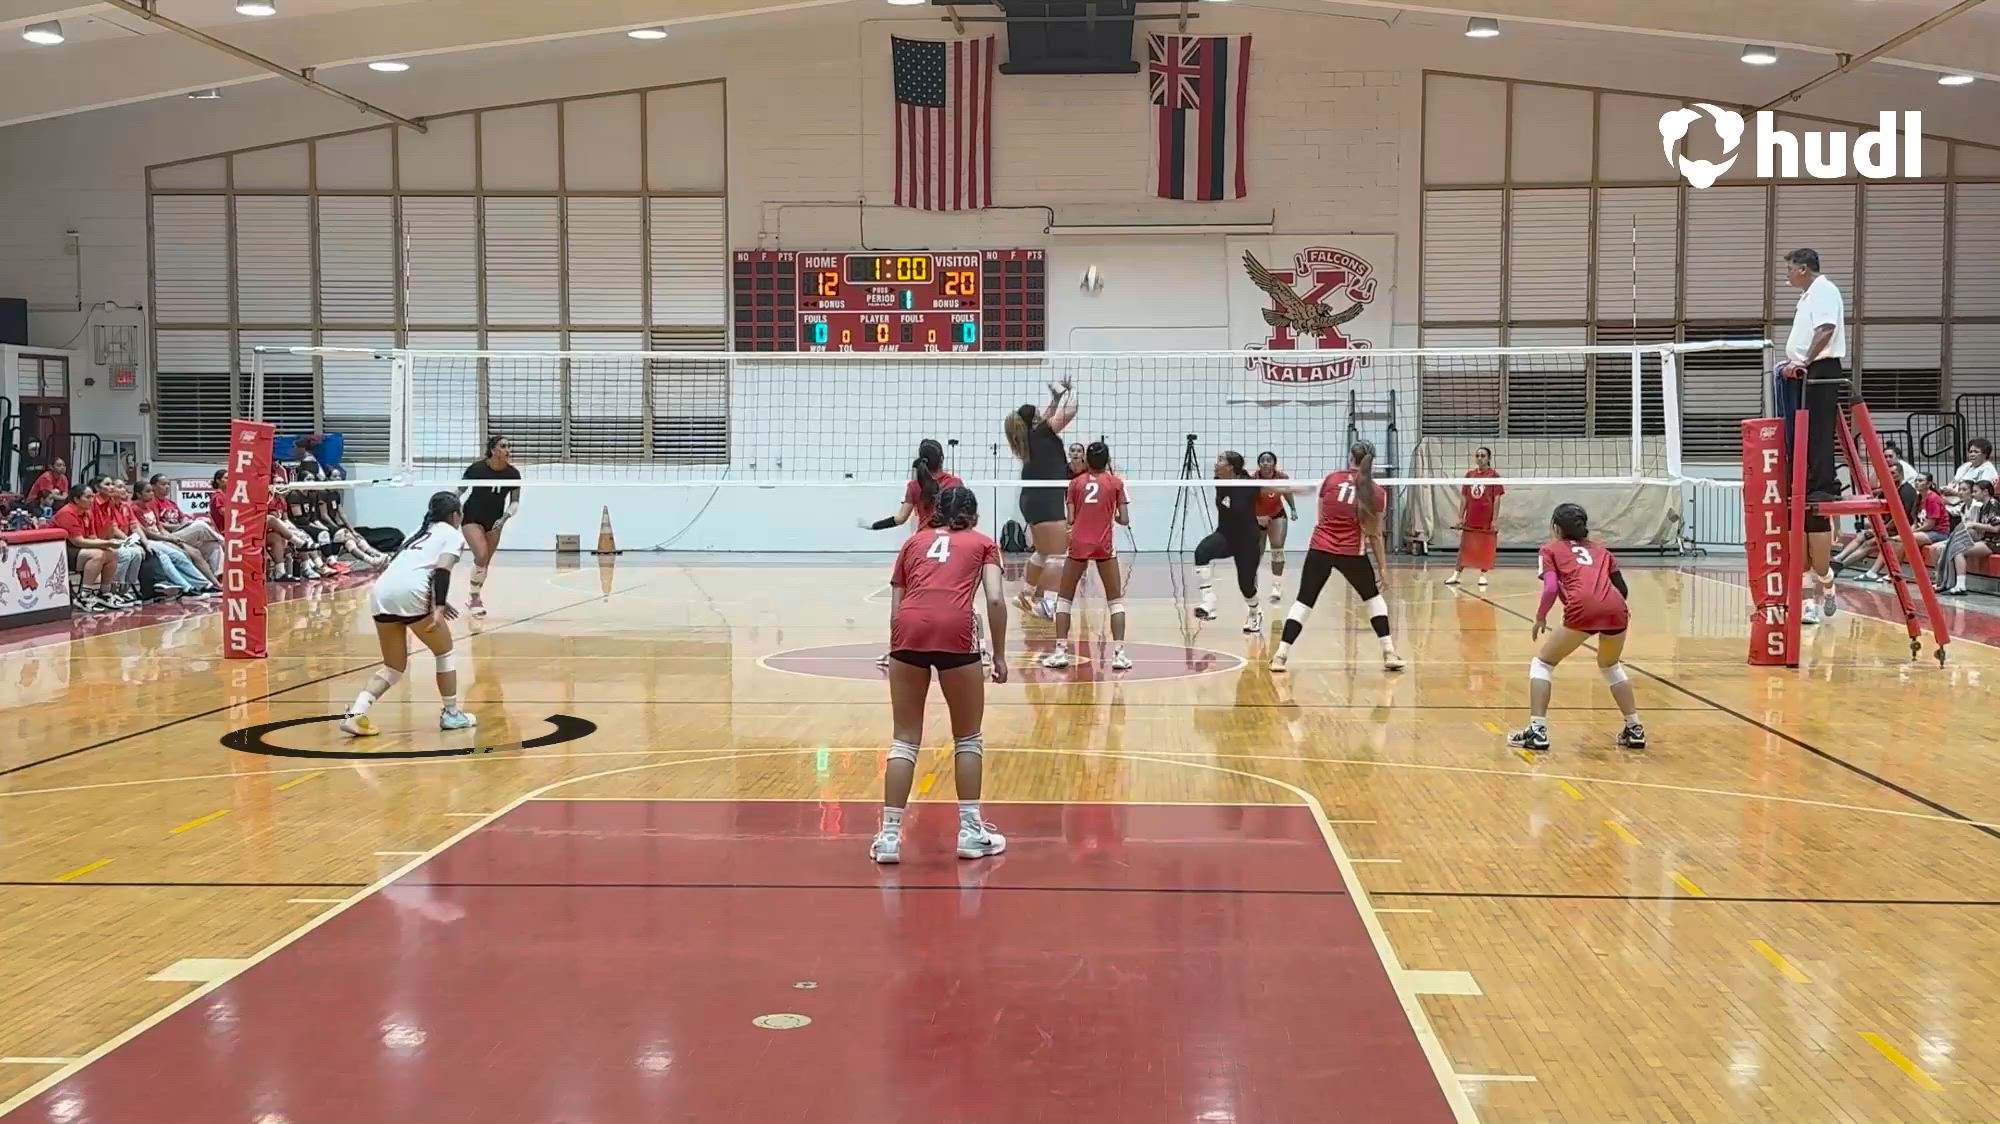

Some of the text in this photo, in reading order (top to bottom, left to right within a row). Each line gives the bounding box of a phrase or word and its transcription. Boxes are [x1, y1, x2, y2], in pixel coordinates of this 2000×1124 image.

[738, 252, 793, 261] NO F PTS
[805, 257, 838, 268] HOME
[935, 255, 979, 267] VISITOR
[986, 251, 1042, 260] NO F PTS
[1310, 251, 1366, 275] FALCONS
[875, 257, 927, 280] 1:00
[818, 272, 839, 296] 12
[945, 271, 975, 295] 20
[819, 300, 845, 308] BONUS
[866, 294, 895, 303] PERIOD
[906, 289, 912, 309] 1
[932, 300, 959, 308] BONUS
[804, 314, 828, 323] FOULS
[860, 314, 924, 323] PLAYER FOULS
[951, 314, 975, 322] FOULS
[815, 323, 828, 343] 0
[842, 330, 851, 343] 0
[877, 323, 889, 343] 0
[928, 329, 937, 343] 0
[963, 323, 975, 343] 0
[1266, 361, 1349, 381] KALANI
[1084, 482, 1099, 504] 2
[1337, 482, 1356, 504] 11
[227, 450, 254, 651] FALCONS
[926, 536, 951, 563] 4
[1571, 546, 1593, 565] 3
[1761, 449, 1787, 656] FALCONS
